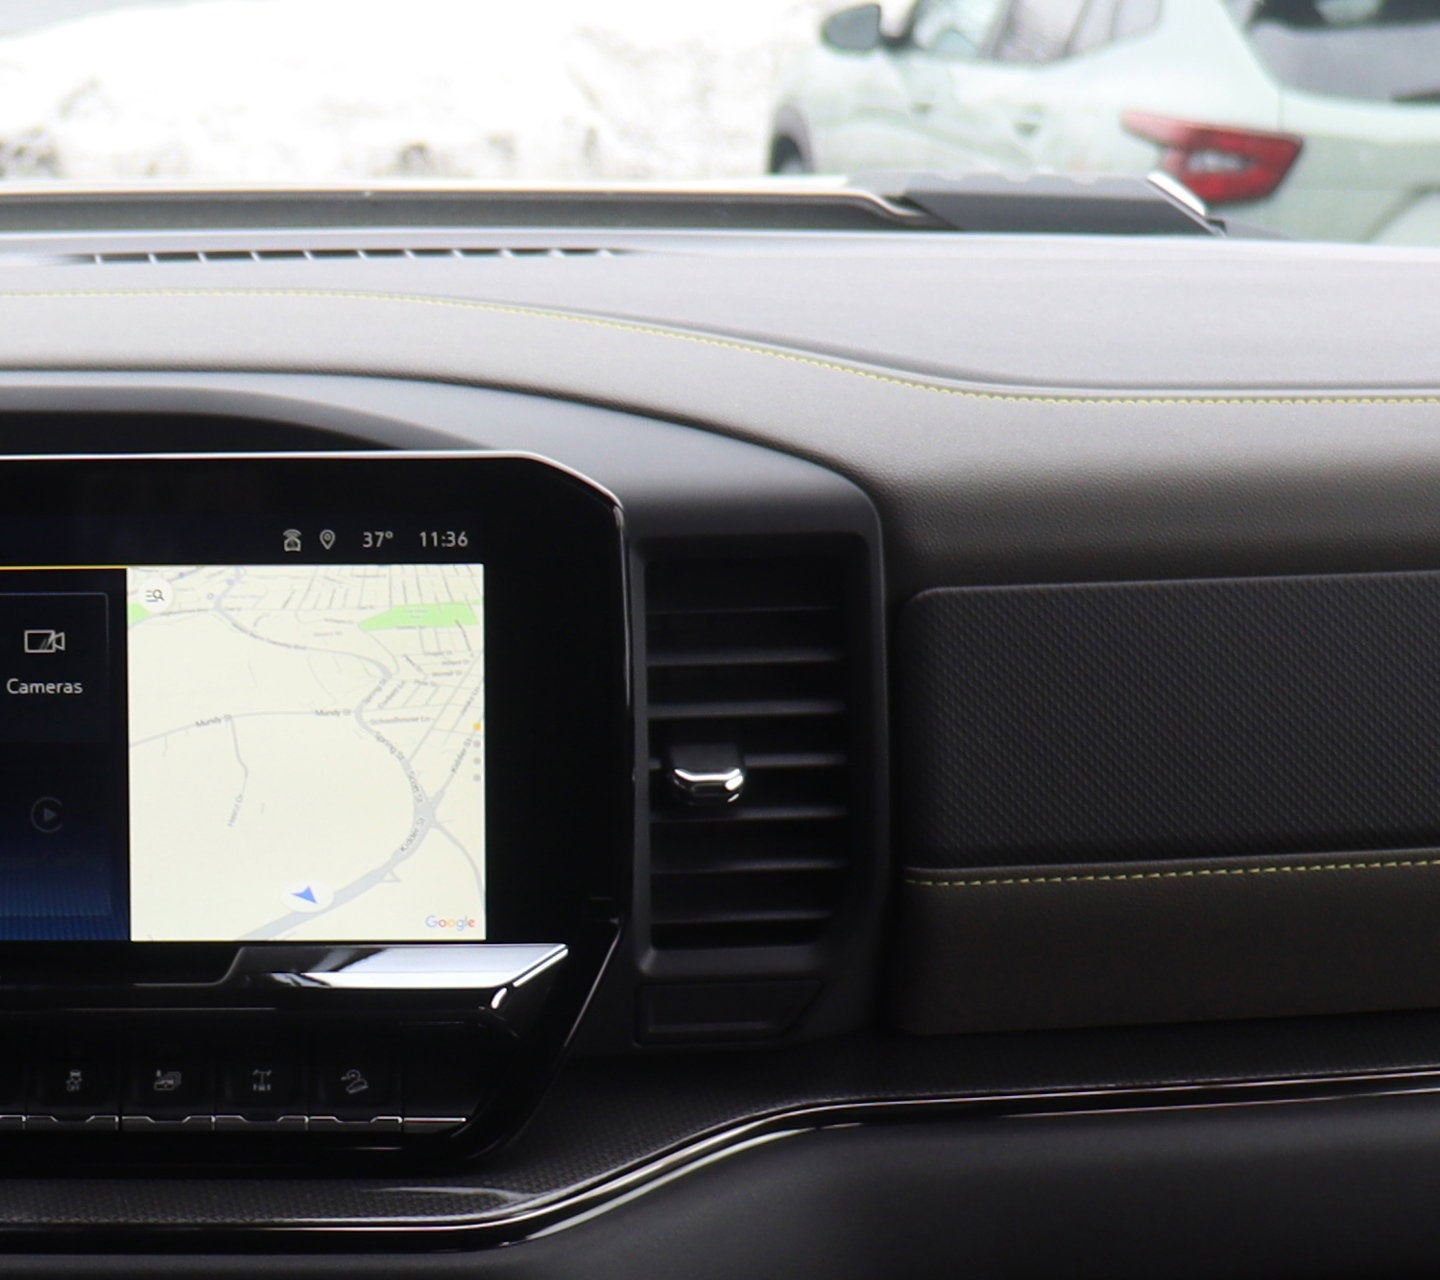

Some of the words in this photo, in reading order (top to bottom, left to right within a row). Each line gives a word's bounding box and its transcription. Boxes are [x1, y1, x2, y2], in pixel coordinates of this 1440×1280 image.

[361, 530, 394, 549] 37°
[419, 531, 469, 549] 11:36
[6, 677, 83, 696] Cameras
[425, 914, 476, 932] Google
